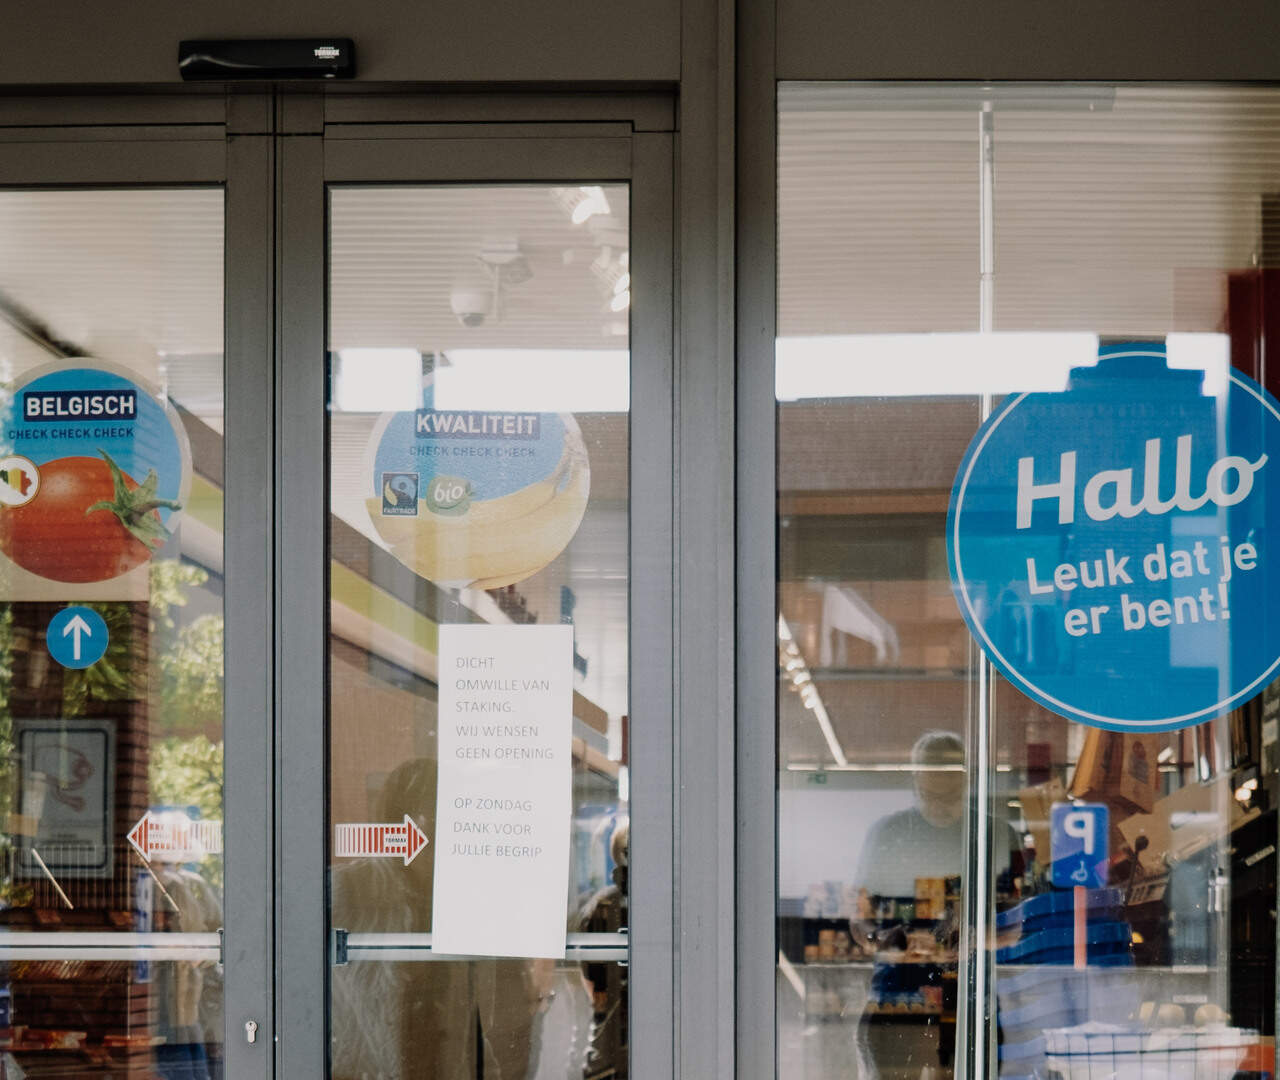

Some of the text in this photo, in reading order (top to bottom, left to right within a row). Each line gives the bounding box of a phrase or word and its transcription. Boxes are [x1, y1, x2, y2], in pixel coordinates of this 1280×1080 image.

[26, 395, 134, 417] BELGISCH
[416, 413, 537, 435] KWALITEIT
[8, 426, 134, 440] CHECK CHECK CHECK
[409, 446, 536, 457] CHECK CHECK CHECK
[1016, 433, 1269, 529] Hallo
[433, 481, 464, 503] bio
[1026, 535, 1258, 595] Leuk dat je
[1064, 582, 1231, 637] er bent!
[455, 656, 496, 669] DICHT
[455, 679, 550, 691] OMWILLE VAN
[455, 725, 539, 737] WIJ WENSEN
[455, 747, 554, 760] GEEN OPENING
[454, 797, 533, 812] OP ZONDAG
[453, 821, 532, 836] DANK VOOR
[451, 843, 543, 858] JULLIE BEGRIP
